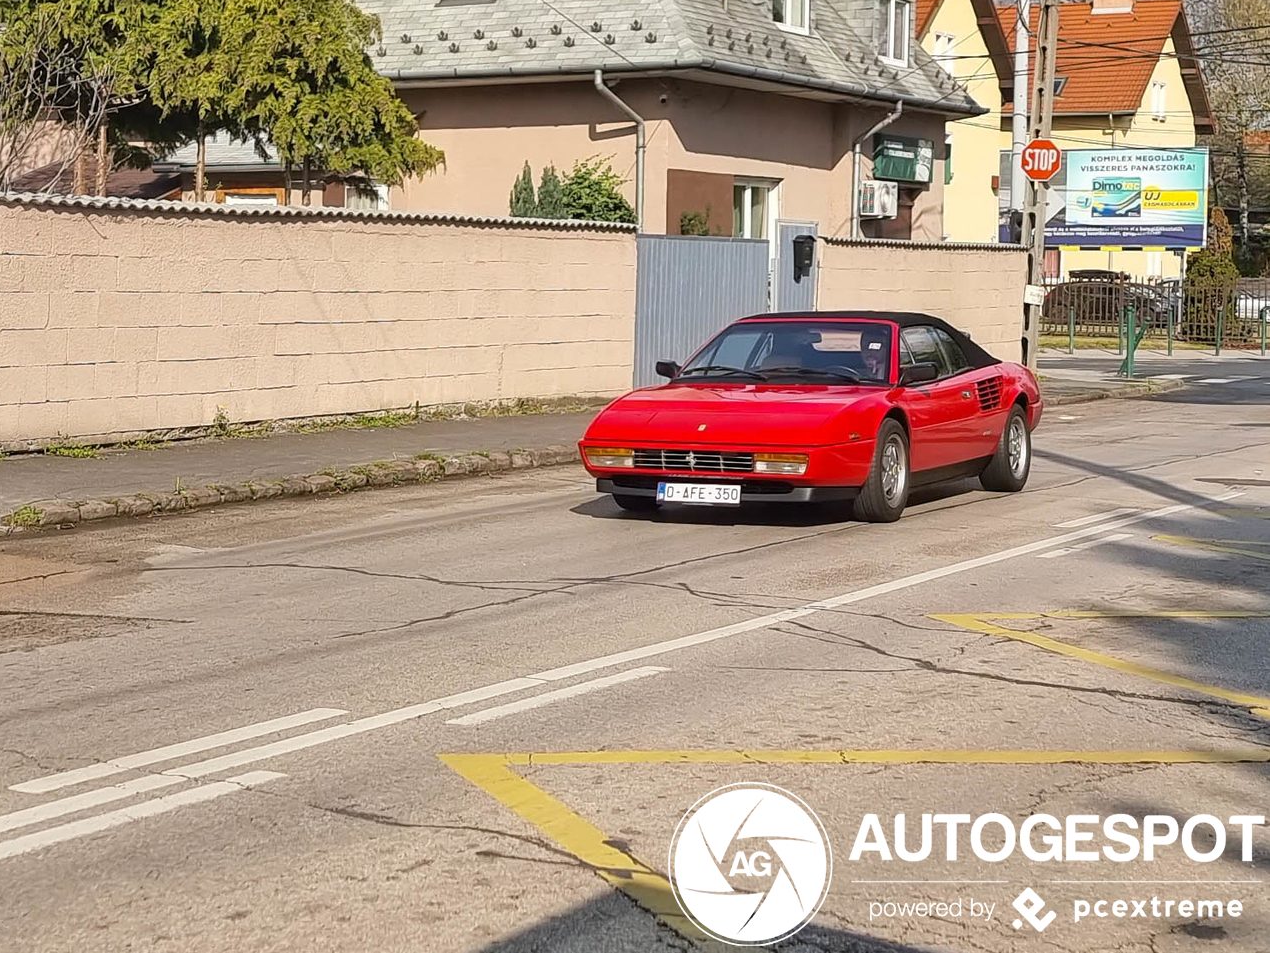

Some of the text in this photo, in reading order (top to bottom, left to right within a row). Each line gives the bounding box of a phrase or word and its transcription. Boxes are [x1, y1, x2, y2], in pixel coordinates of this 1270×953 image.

[1024, 149, 1057, 172] STOP
[1091, 154, 1185, 163] KOMPLEX MEGOLDÁS
[1080, 164, 1196, 173] VISSZERES PANASZOKRA!
